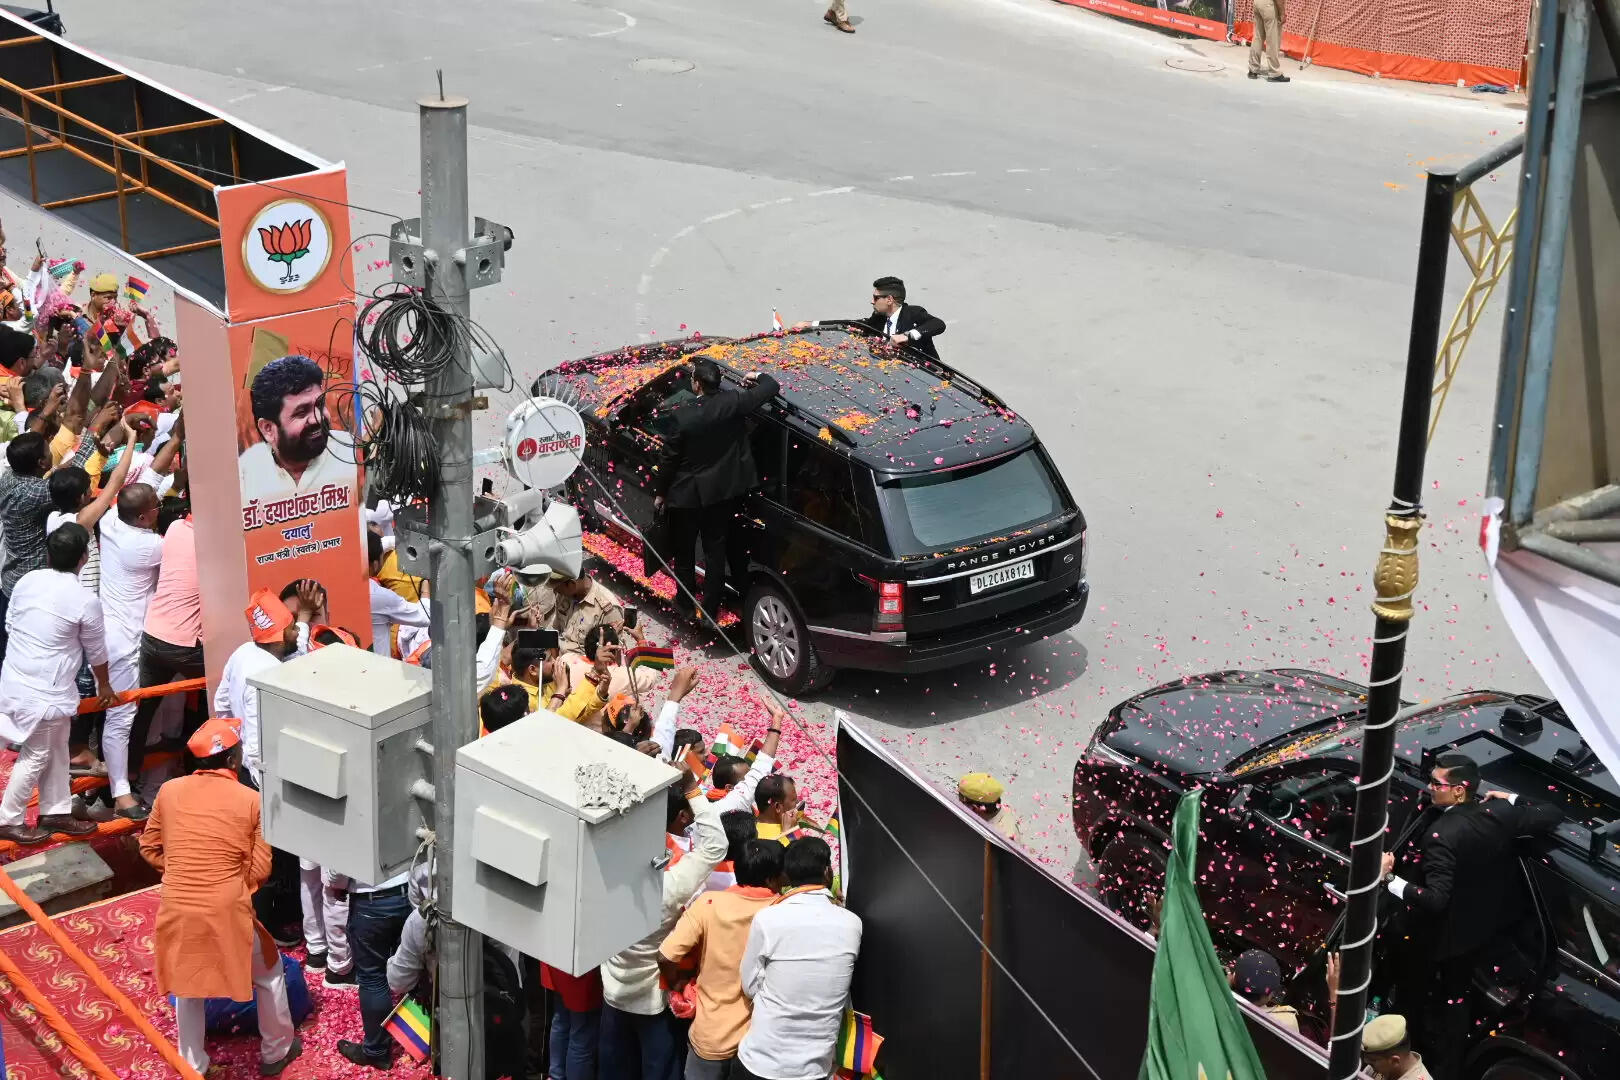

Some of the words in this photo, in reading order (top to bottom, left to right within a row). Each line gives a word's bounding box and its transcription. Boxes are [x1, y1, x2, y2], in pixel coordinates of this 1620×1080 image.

[538, 434, 581, 453] वाराणसी
[242, 499, 262, 527] डॉ.
[264, 493, 318, 521] दयाशंकर
[320, 484, 350, 510] मिश्र
[256, 553, 274, 564] राज्य
[276, 547, 290, 559] मंत्री
[292, 541, 321, 558] (स्वतंत्र)
[322, 537, 341, 549] प्रभार
[947, 553, 999, 569] RANGE
[1008, 535, 1055, 554] ROVER
[977, 563, 1032, 588] DL2CAX8121
